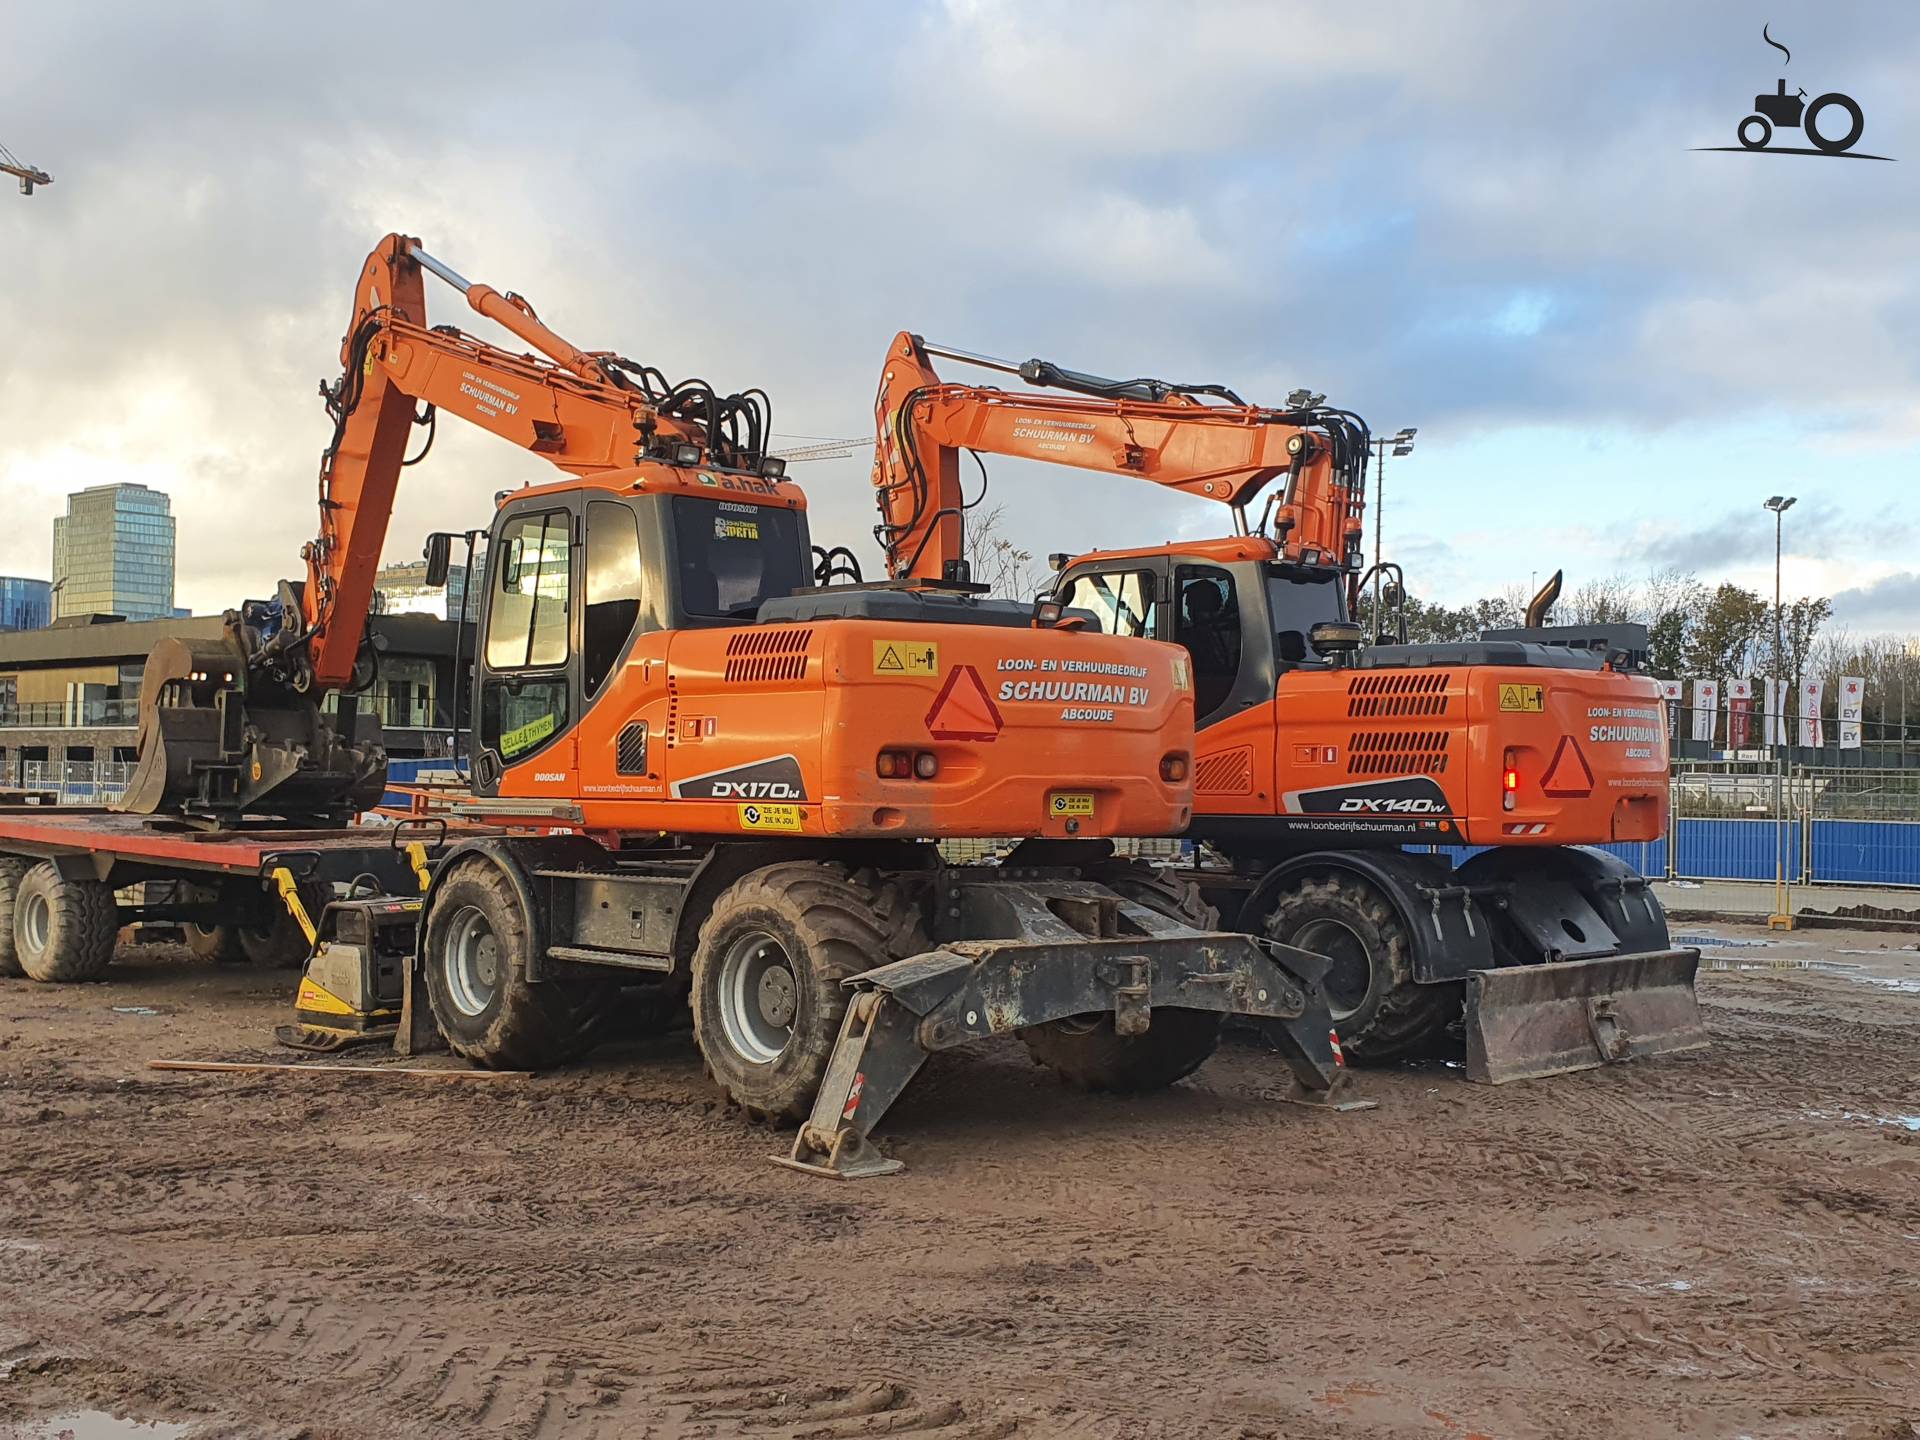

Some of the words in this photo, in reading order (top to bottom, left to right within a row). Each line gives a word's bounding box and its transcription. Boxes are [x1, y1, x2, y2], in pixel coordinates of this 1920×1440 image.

[459, 382, 506, 410] SCHUURMAN
[505, 402, 518, 415] BV
[1013, 427, 1078, 442] SCHUURMAN
[1079, 433, 1096, 444] BV
[721, 477, 780, 496] a.hak
[718, 502, 759, 513] DOOSAN
[997, 659, 1037, 671] LOON-
[1041, 660, 1057, 671] EN
[1061, 661, 1148, 678] VERHUURBEDRIJF
[999, 681, 1125, 704] SCHUURMAN
[1129, 686, 1149, 705] BV
[1061, 708, 1113, 721] ABCOUDE
[1587, 707, 1611, 717] LOON-
[1612, 708, 1622, 717] EN
[1843, 708, 1858, 719] EY
[1590, 726, 1655, 742] SCHUURMAN
[1843, 731, 1857, 741] EY
[534, 773, 565, 782] DOOSAN
[764, 816, 774, 824] ZIE
[782, 817, 794, 825] JOU
[1288, 820, 1416, 833] www.loonbedrijfschuurman.nl
